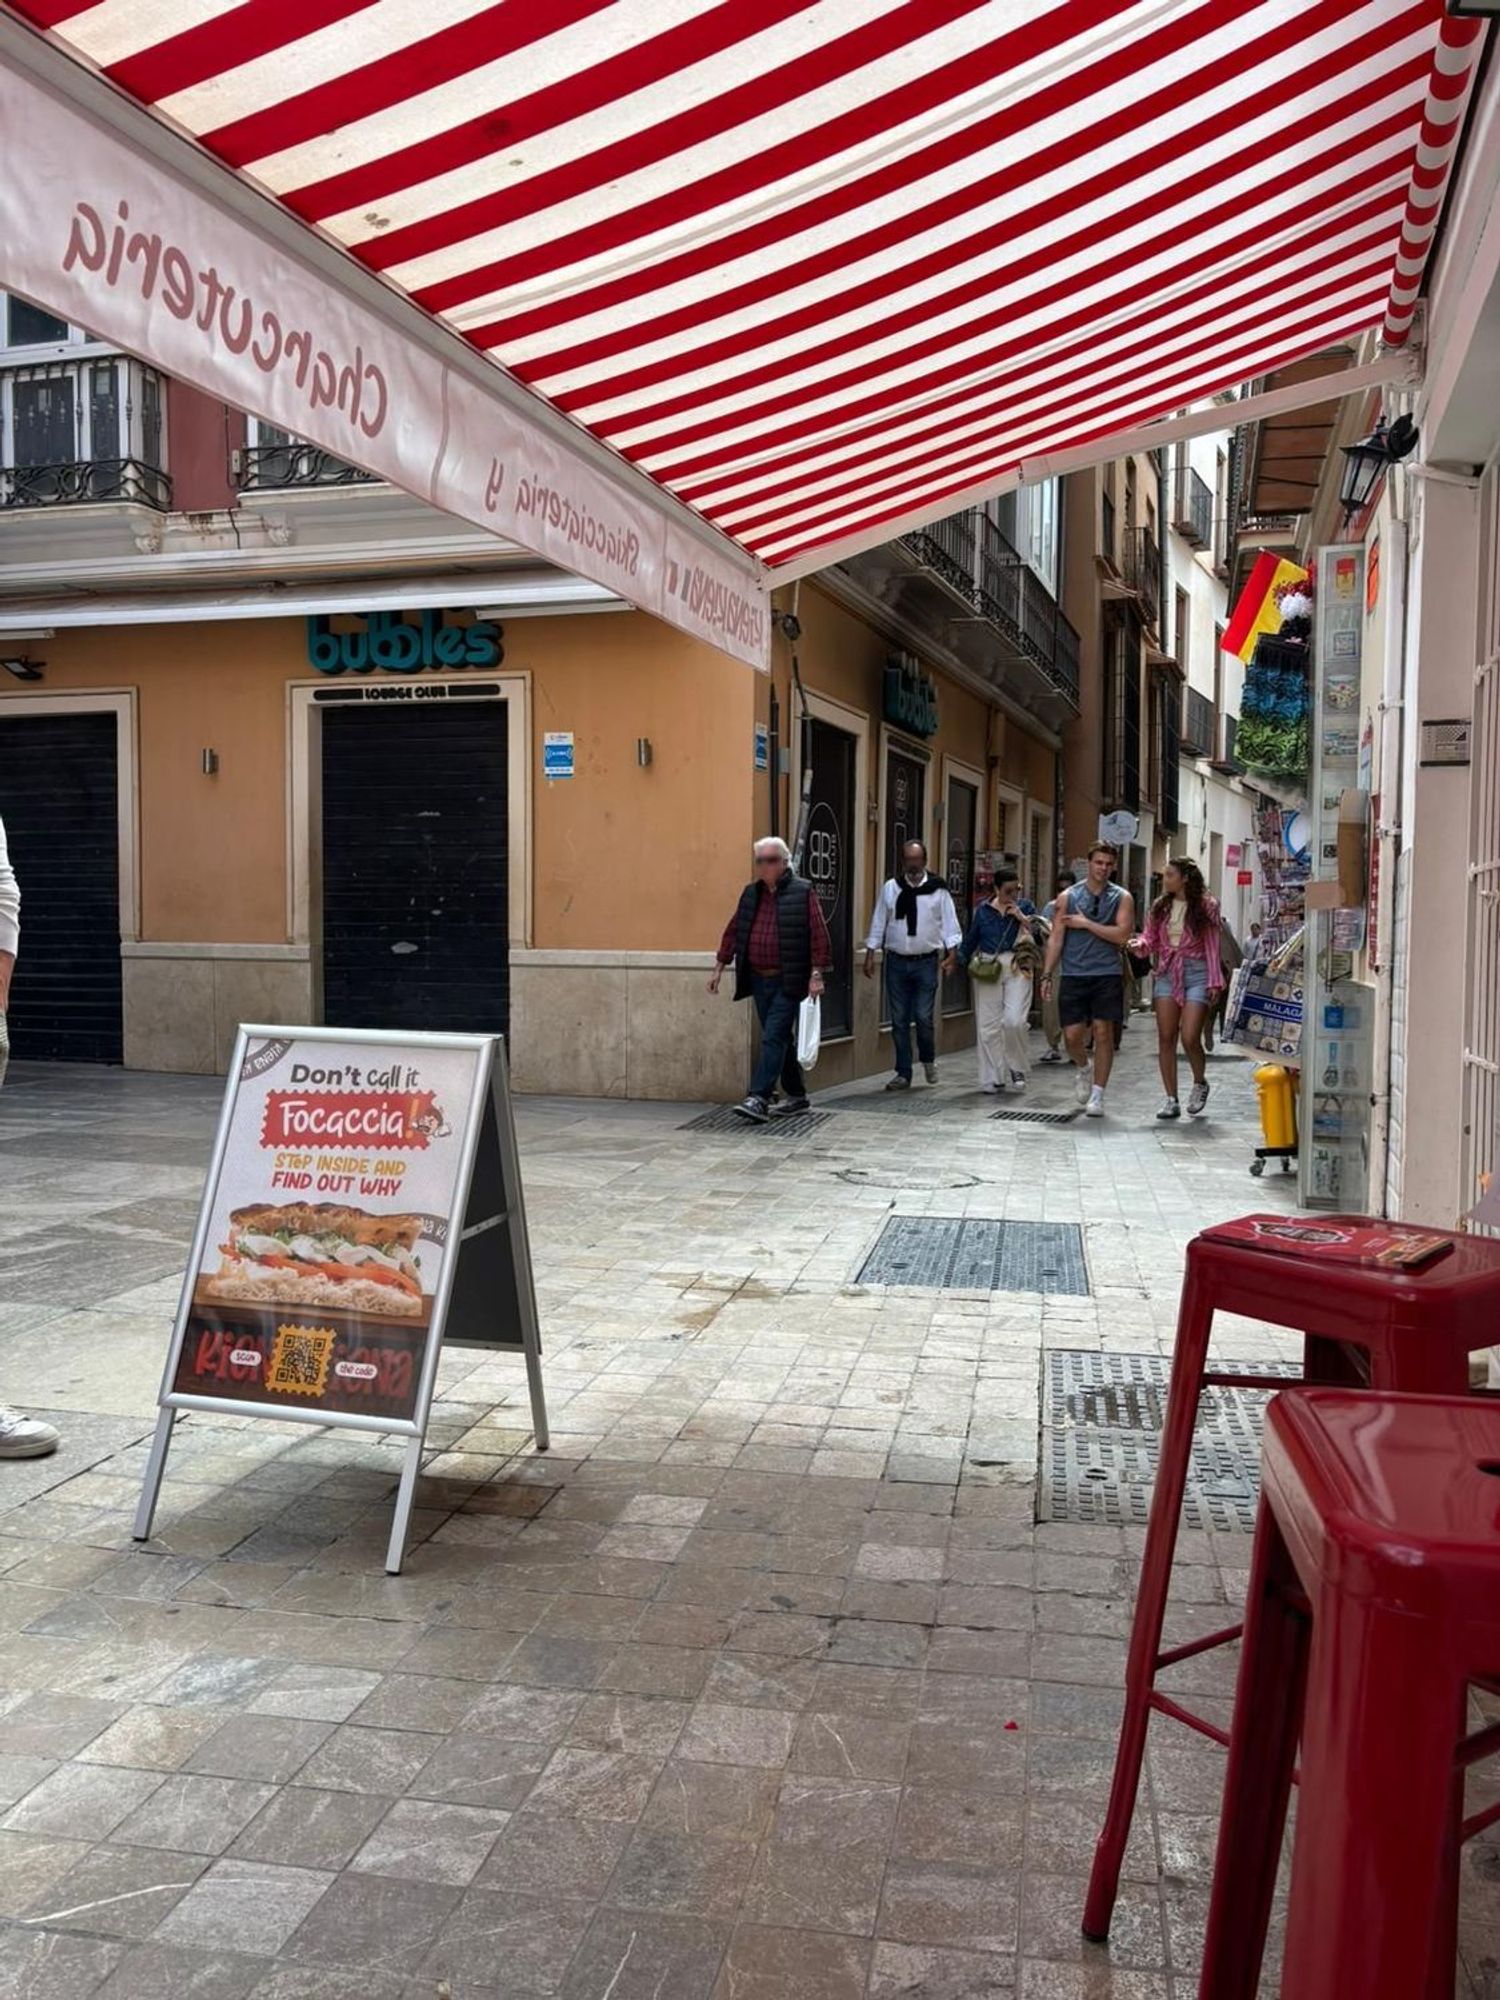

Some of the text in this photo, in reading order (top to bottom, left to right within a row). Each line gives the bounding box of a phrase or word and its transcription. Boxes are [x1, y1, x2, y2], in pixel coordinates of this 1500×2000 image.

[307, 608, 502, 674] bubbles
[290, 1064, 420, 1089] Don't call it
[279, 1099, 419, 1139] Focaccia!
[316, 1155, 370, 1174] INSIDE
[374, 1160, 407, 1176] AND
[271, 1171, 403, 1197] FIND OUT WHY
